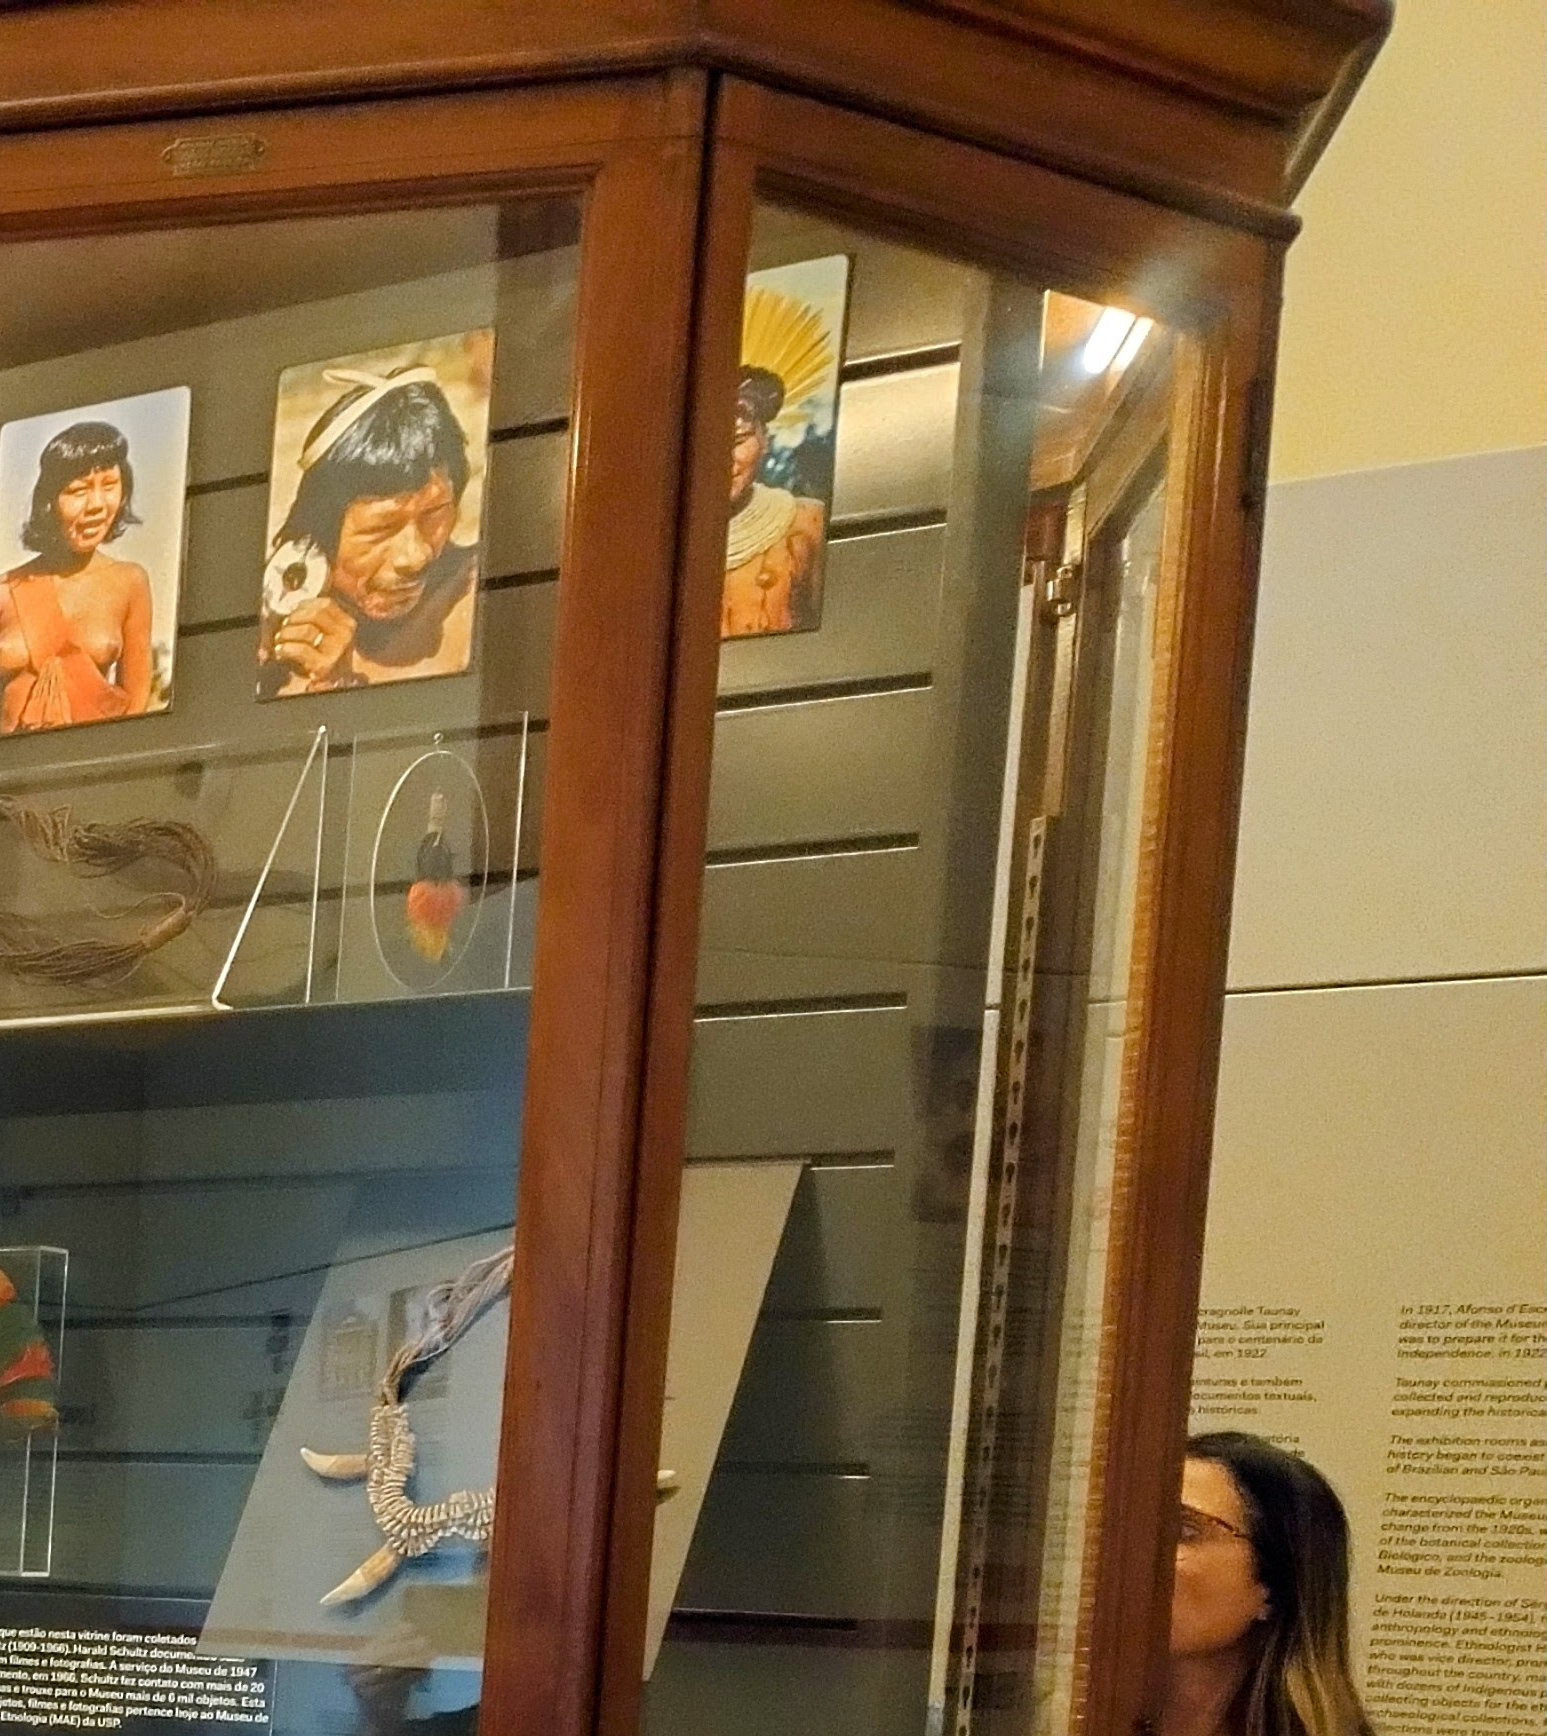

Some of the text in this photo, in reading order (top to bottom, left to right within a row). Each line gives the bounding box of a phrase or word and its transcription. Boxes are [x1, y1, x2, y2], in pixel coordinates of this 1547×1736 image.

[1401, 1305, 1413, 1315] In
[1455, 1304, 1503, 1314] Afonso
[1399, 1319, 1493, 1329] director of the
[1427, 1333, 1440, 1343] to
[1442, 1336, 1495, 1345] prepare
[1510, 1333, 1530, 1343] for
[1391, 1406, 1485, 1418] expanding the
[1390, 1435, 1413, 1445] The
[1484, 1438, 1527, 1446] rooms
[1435, 1450, 1477, 1462] began
[1385, 1492, 1409, 1502] The
[1466, 1523, 1488, 1533] the
[1419, 1536, 1481, 1547] botanical
[1474, 1552, 1497, 1562] the
[18, 1628, 47, 1638] estão
[47, 1629, 76, 1640] nesta
[111, 1632, 143, 1643] foram
[144, 1634, 197, 1645] coletados
[72, 1645, 107, 1656] Harald
[109, 1647, 148, 1658] Schultz
[9, 1656, 39, 1667] filmes
[41, 1659, 48, 1667] e
[49, 1658, 107, 1672] fotografias.
[108, 1661, 117, 1670] A
[119, 1661, 157, 1675] serviço
[158, 1663, 173, 1673] do
[175, 1664, 212, 1675] Museu
[213, 1666, 227, 1676] de
[230, 1667, 257, 1677] 1947
[32, 1673, 49, 1681] em
[80, 1674, 119, 1685] Schultz
[120, 1676, 136, 1686] fez
[137, 1677, 179, 1688] contato
[179, 1681, 204, 1689] com
[205, 1680, 232, 1691] mais
[233, 1682, 248, 1692] de
[249, 1683, 265, 1693] 20
[21, 1685, 53, 1696] trouxe
[54, 1689, 78, 1700] para
[79, 1690, 87, 1698] o
[87, 1689, 124, 1700] Museu
[125, 1691, 151, 1701] mais
[151, 1692, 166, 1702] de
[177, 1693, 193, 1703] mil
[27, 1699, 59, 1710] filmes
[59, 1703, 67, 1711] e
[68, 1701, 123, 1716] fotografias
[125, 1705, 173, 1719] pertence
[174, 1708, 199, 1721] hoje
[199, 1711, 214, 1719] ao
[215, 1710, 253, 1722] Museu
[254, 1712, 269, 1723] de
[0, 1711, 47, 1725] Etnologia
[48, 1714, 81, 1727] (MAE)
[81, 1716, 95, 1726] da
[97, 1717, 123, 1728] USP.
